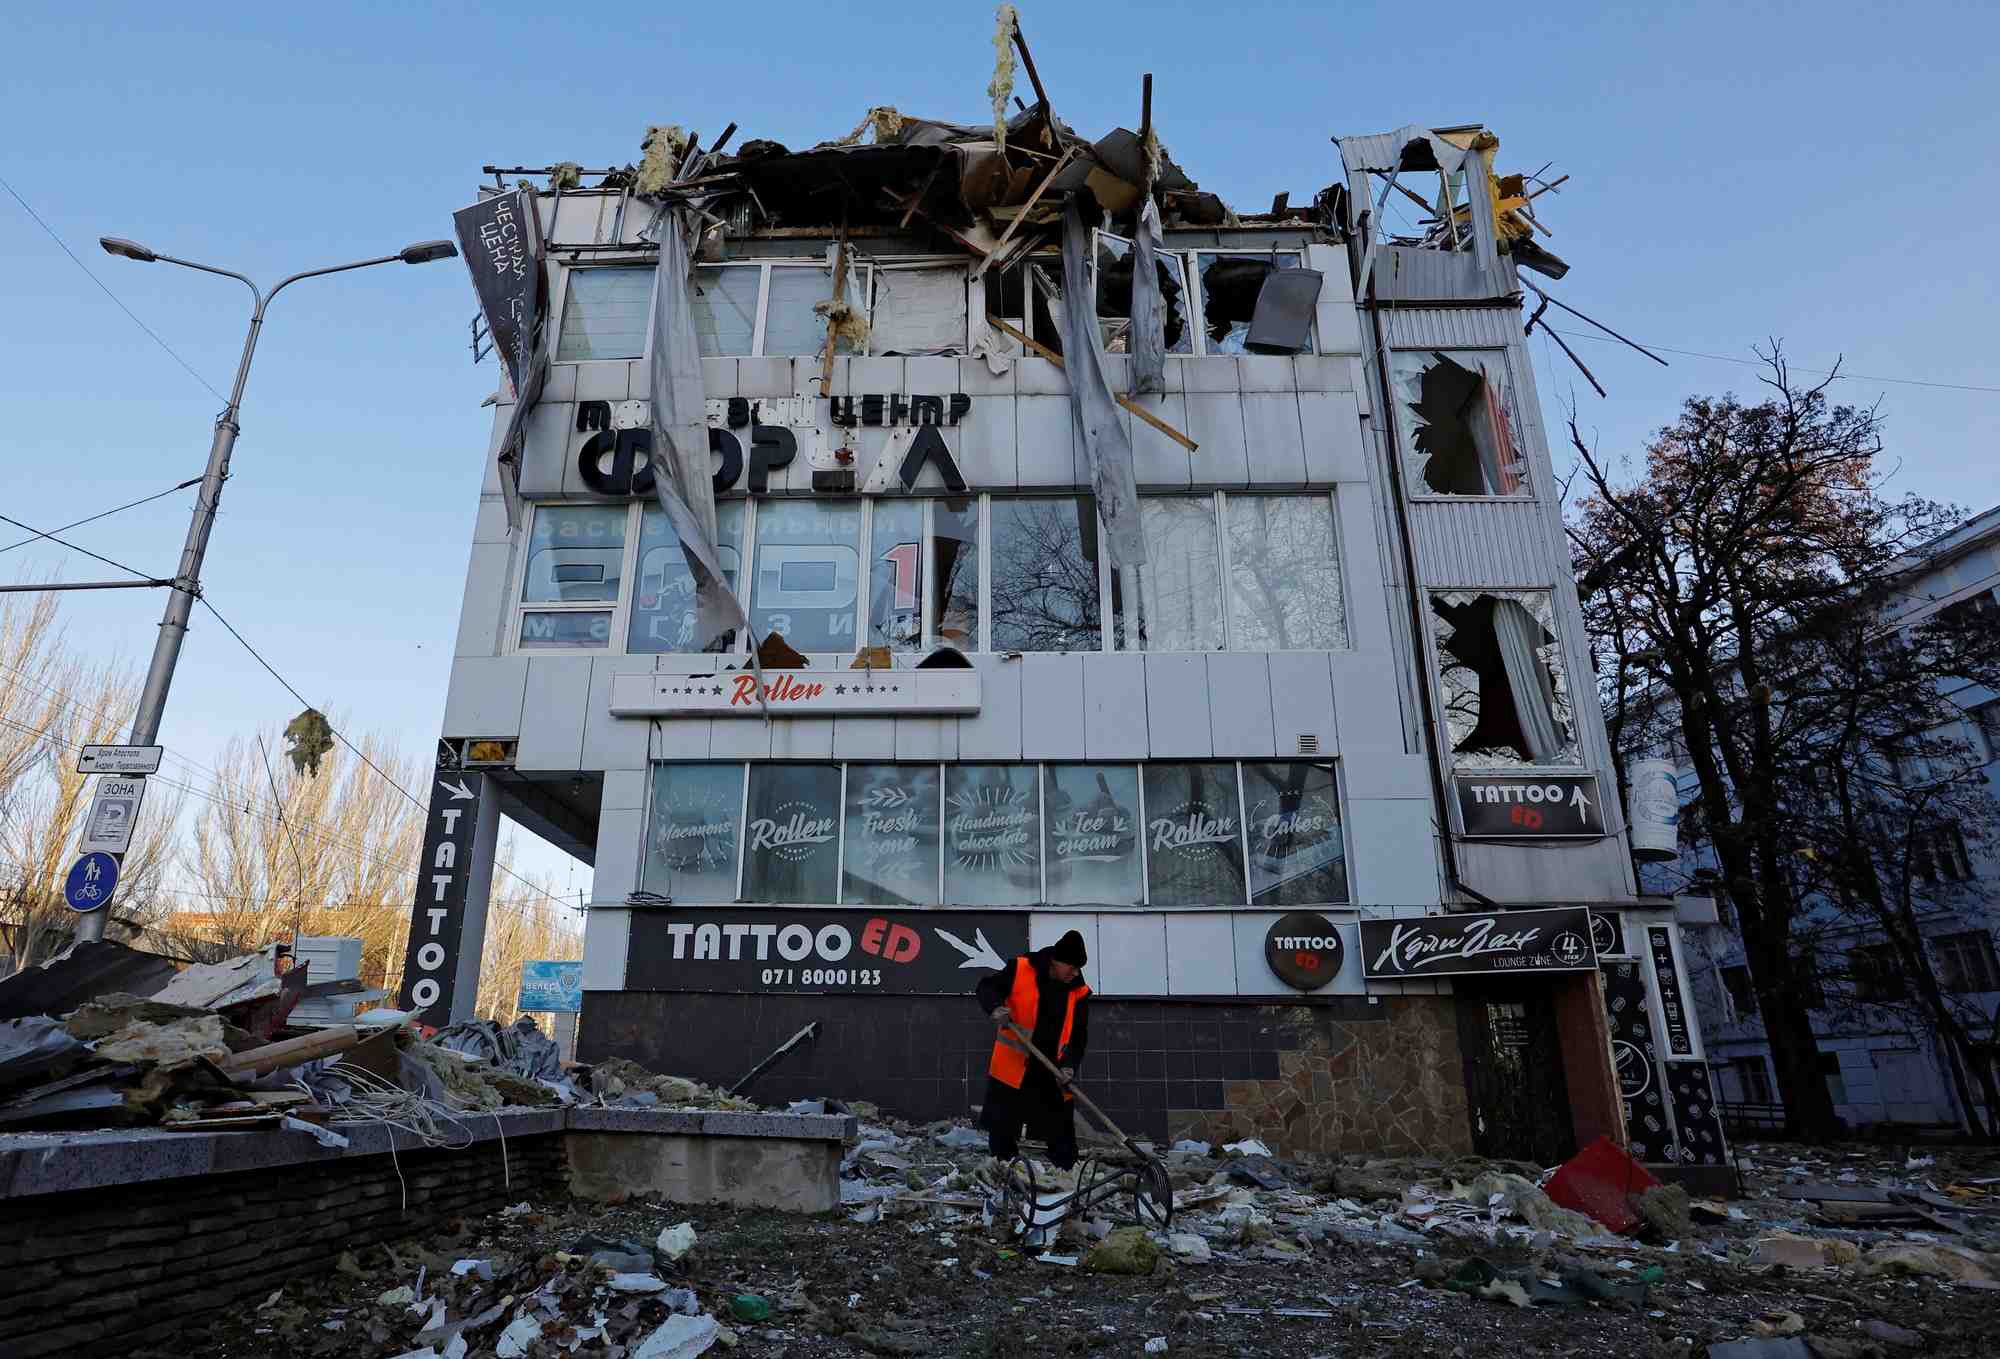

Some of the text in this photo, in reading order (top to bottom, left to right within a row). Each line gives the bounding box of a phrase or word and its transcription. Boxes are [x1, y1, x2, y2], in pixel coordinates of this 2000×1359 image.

[480, 221, 510, 275] ЦЕНА
[730, 673, 825, 706] Rollen
[103, 783, 135, 795] ЗОНА
[1471, 784, 1564, 803] TATTOO
[863, 808, 921, 836] Fresh
[1073, 811, 1105, 832] Ice
[1263, 812, 1323, 840] Cakes
[1511, 805, 1544, 828] ED
[750, 812, 836, 851] Rollen
[1150, 812, 1236, 851] Rollen
[1057, 834, 1121, 854] cream
[412, 808, 462, 1008] TATTOO
[667, 917, 921, 963] TATTOO ED
[1274, 936, 1337, 950] TATTOO
[1562, 937, 1578, 954] 4
[1295, 951, 1320, 970] ED
[762, 969, 881, 985] 071 8000123
